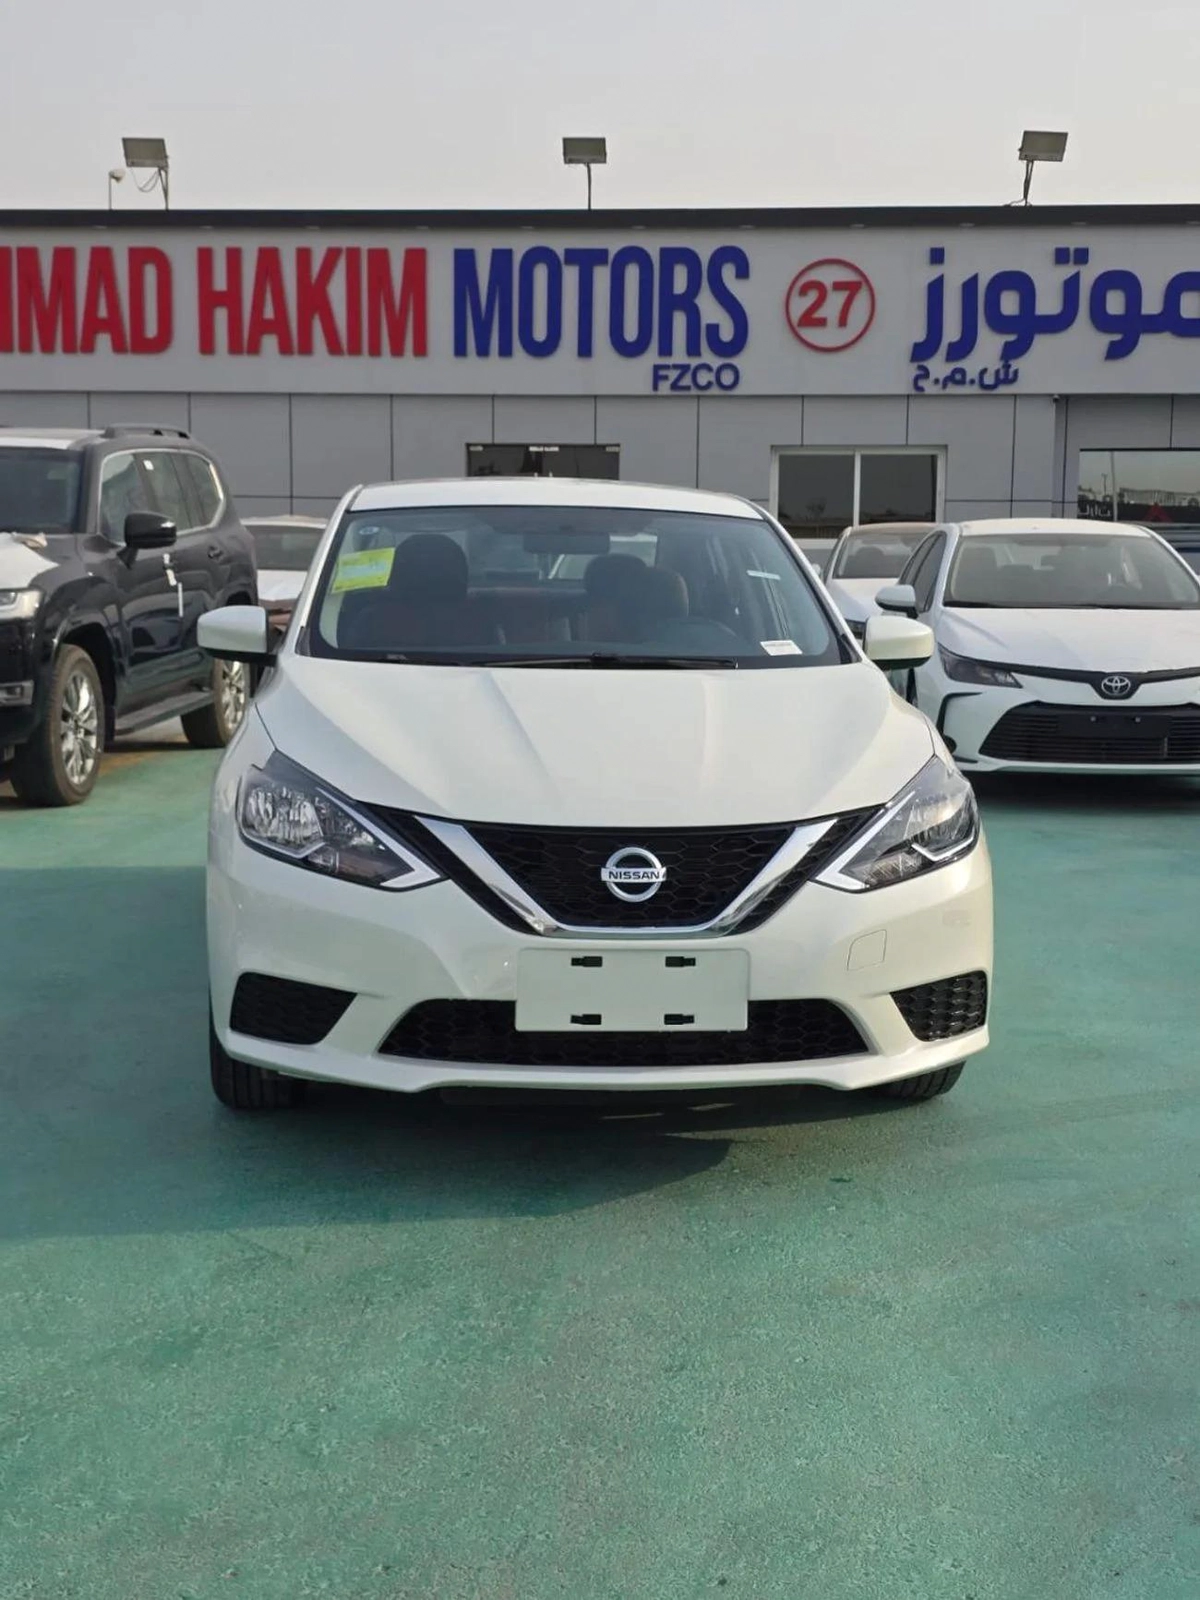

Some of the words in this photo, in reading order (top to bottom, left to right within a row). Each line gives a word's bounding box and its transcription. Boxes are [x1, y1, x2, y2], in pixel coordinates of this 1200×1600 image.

[0, 245, 174, 355] MAD
[196, 246, 428, 357] HAKIM
[453, 244, 751, 359] MOTORS
[796, 280, 863, 329] 27
[652, 362, 740, 391] FZCO
[608, 870, 660, 880] NISSAN
